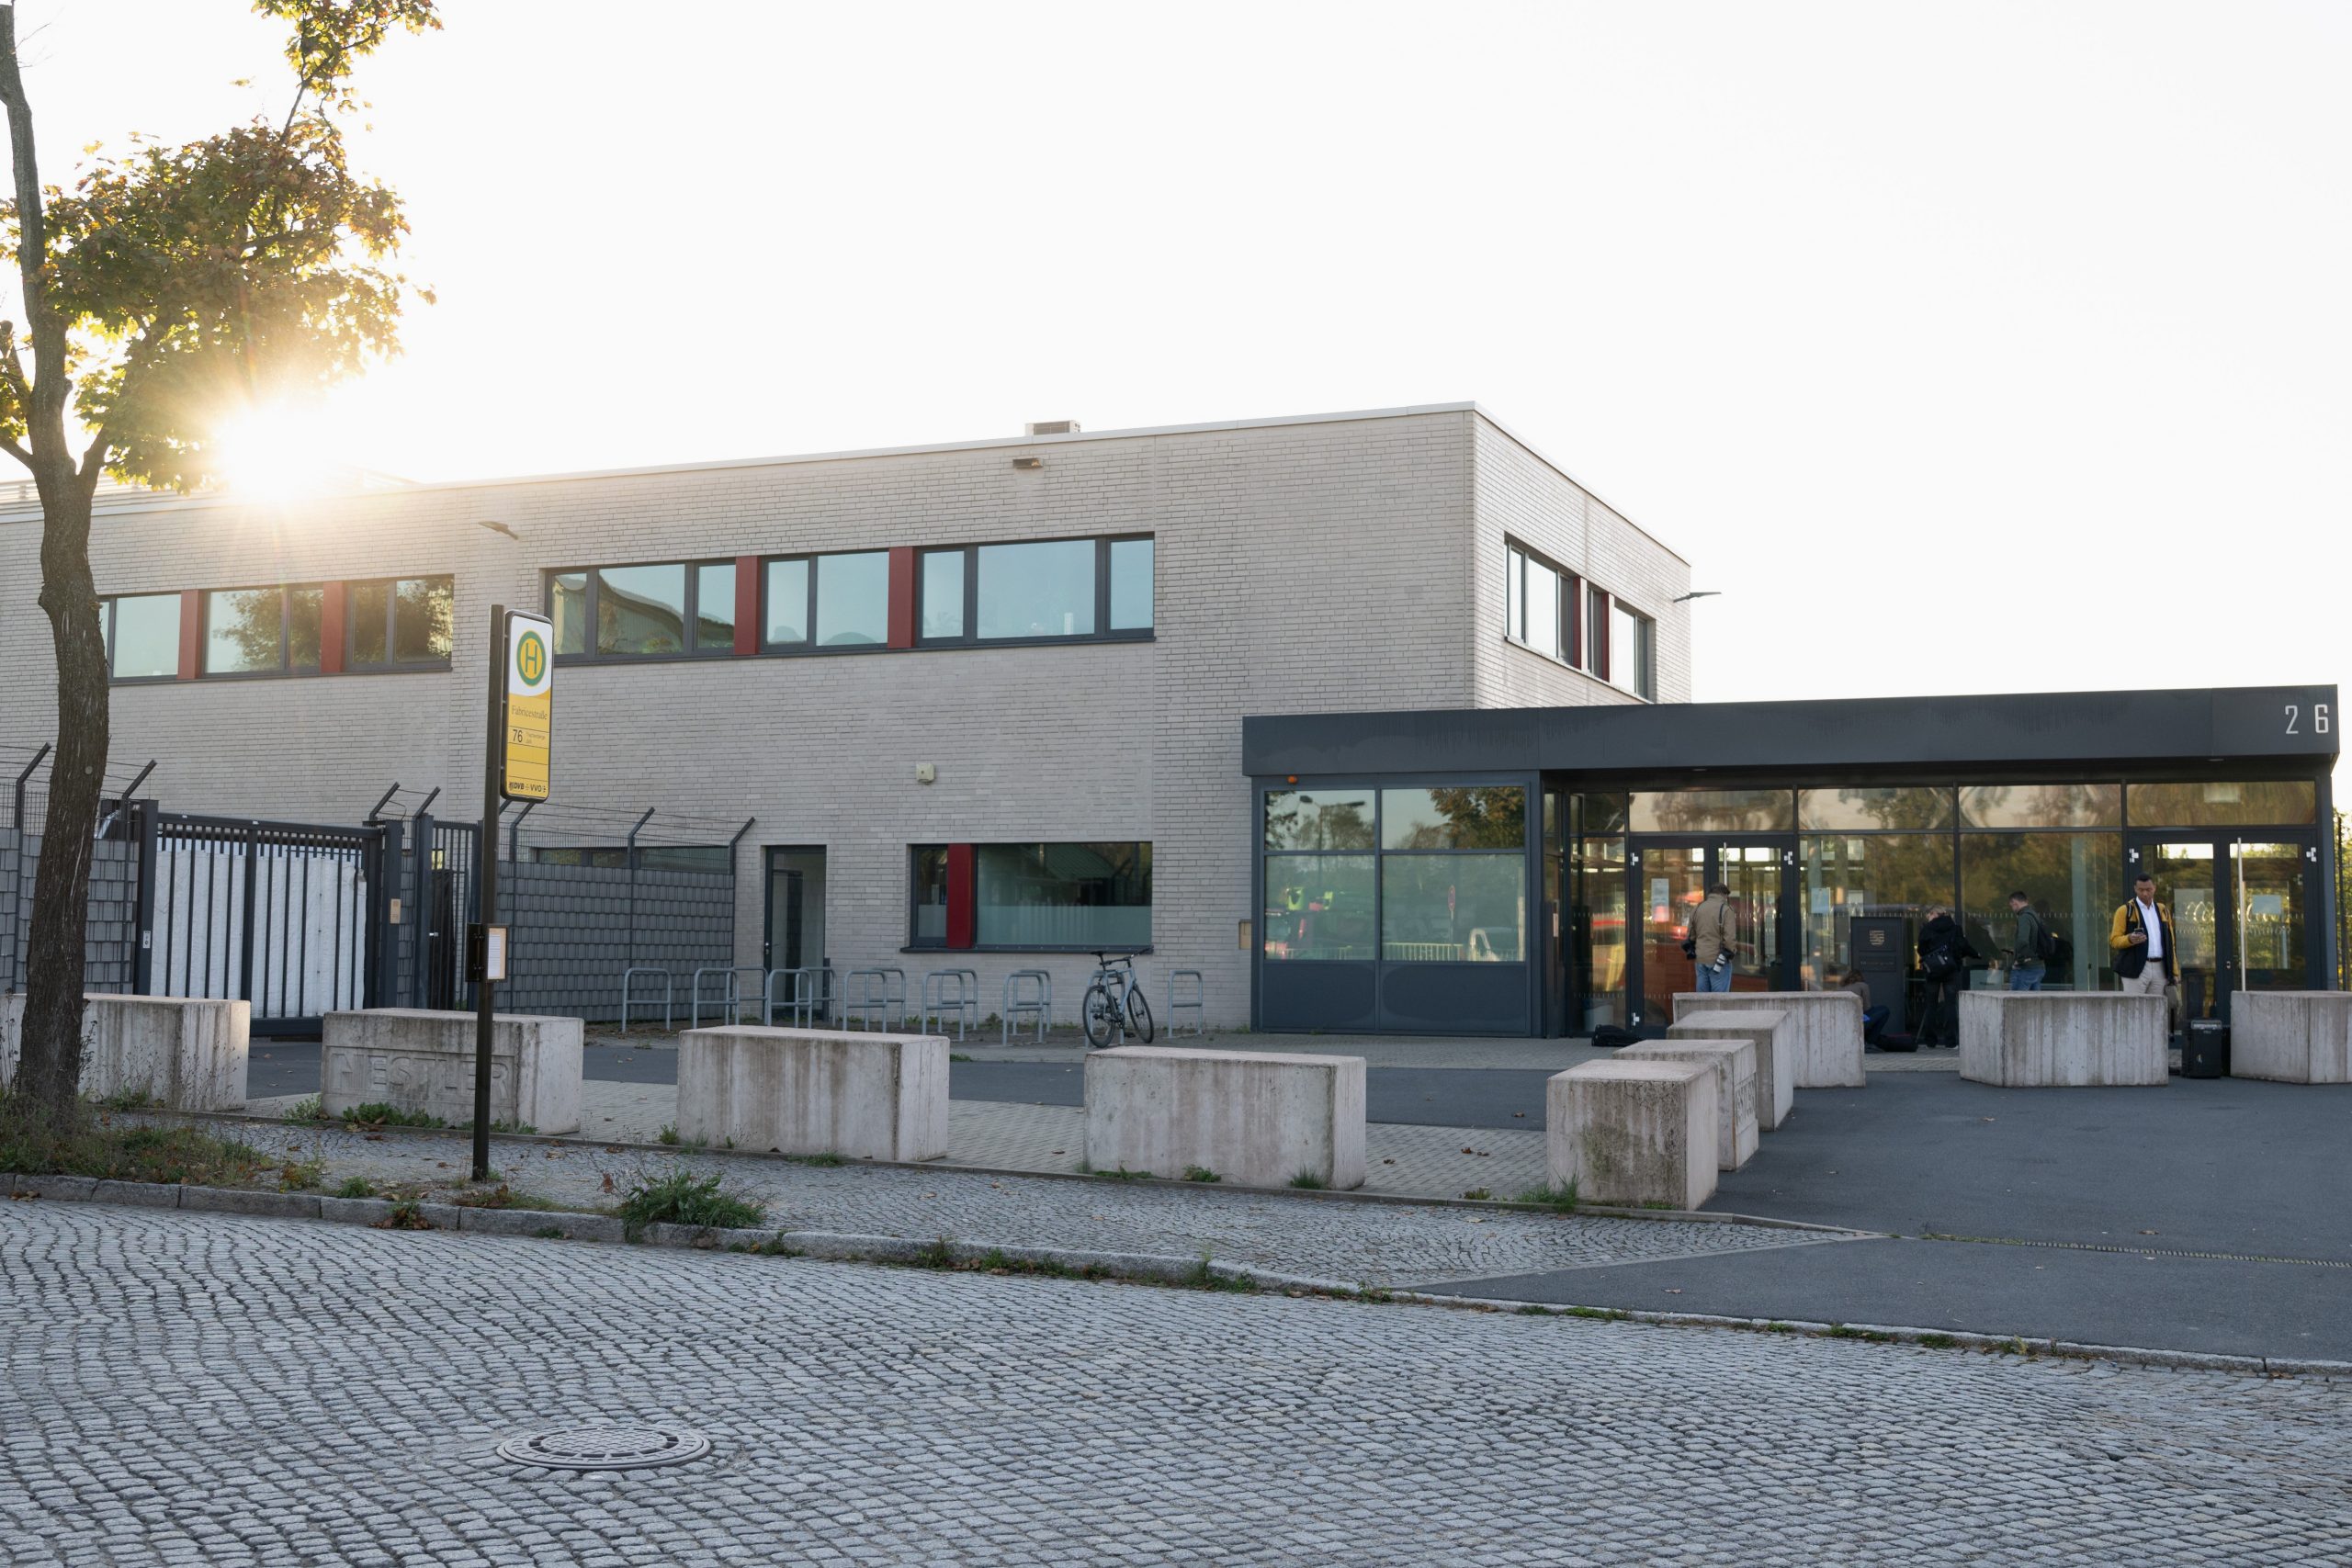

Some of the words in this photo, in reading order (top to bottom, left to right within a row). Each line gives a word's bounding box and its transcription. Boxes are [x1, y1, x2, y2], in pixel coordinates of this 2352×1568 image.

[512, 705, 548, 720] Fabricestraße
[513, 728, 523, 743] 76
[514, 782, 525, 790] DVB
[530, 784, 542, 793] VVO
[332, 1053, 509, 1100] NESTLER
